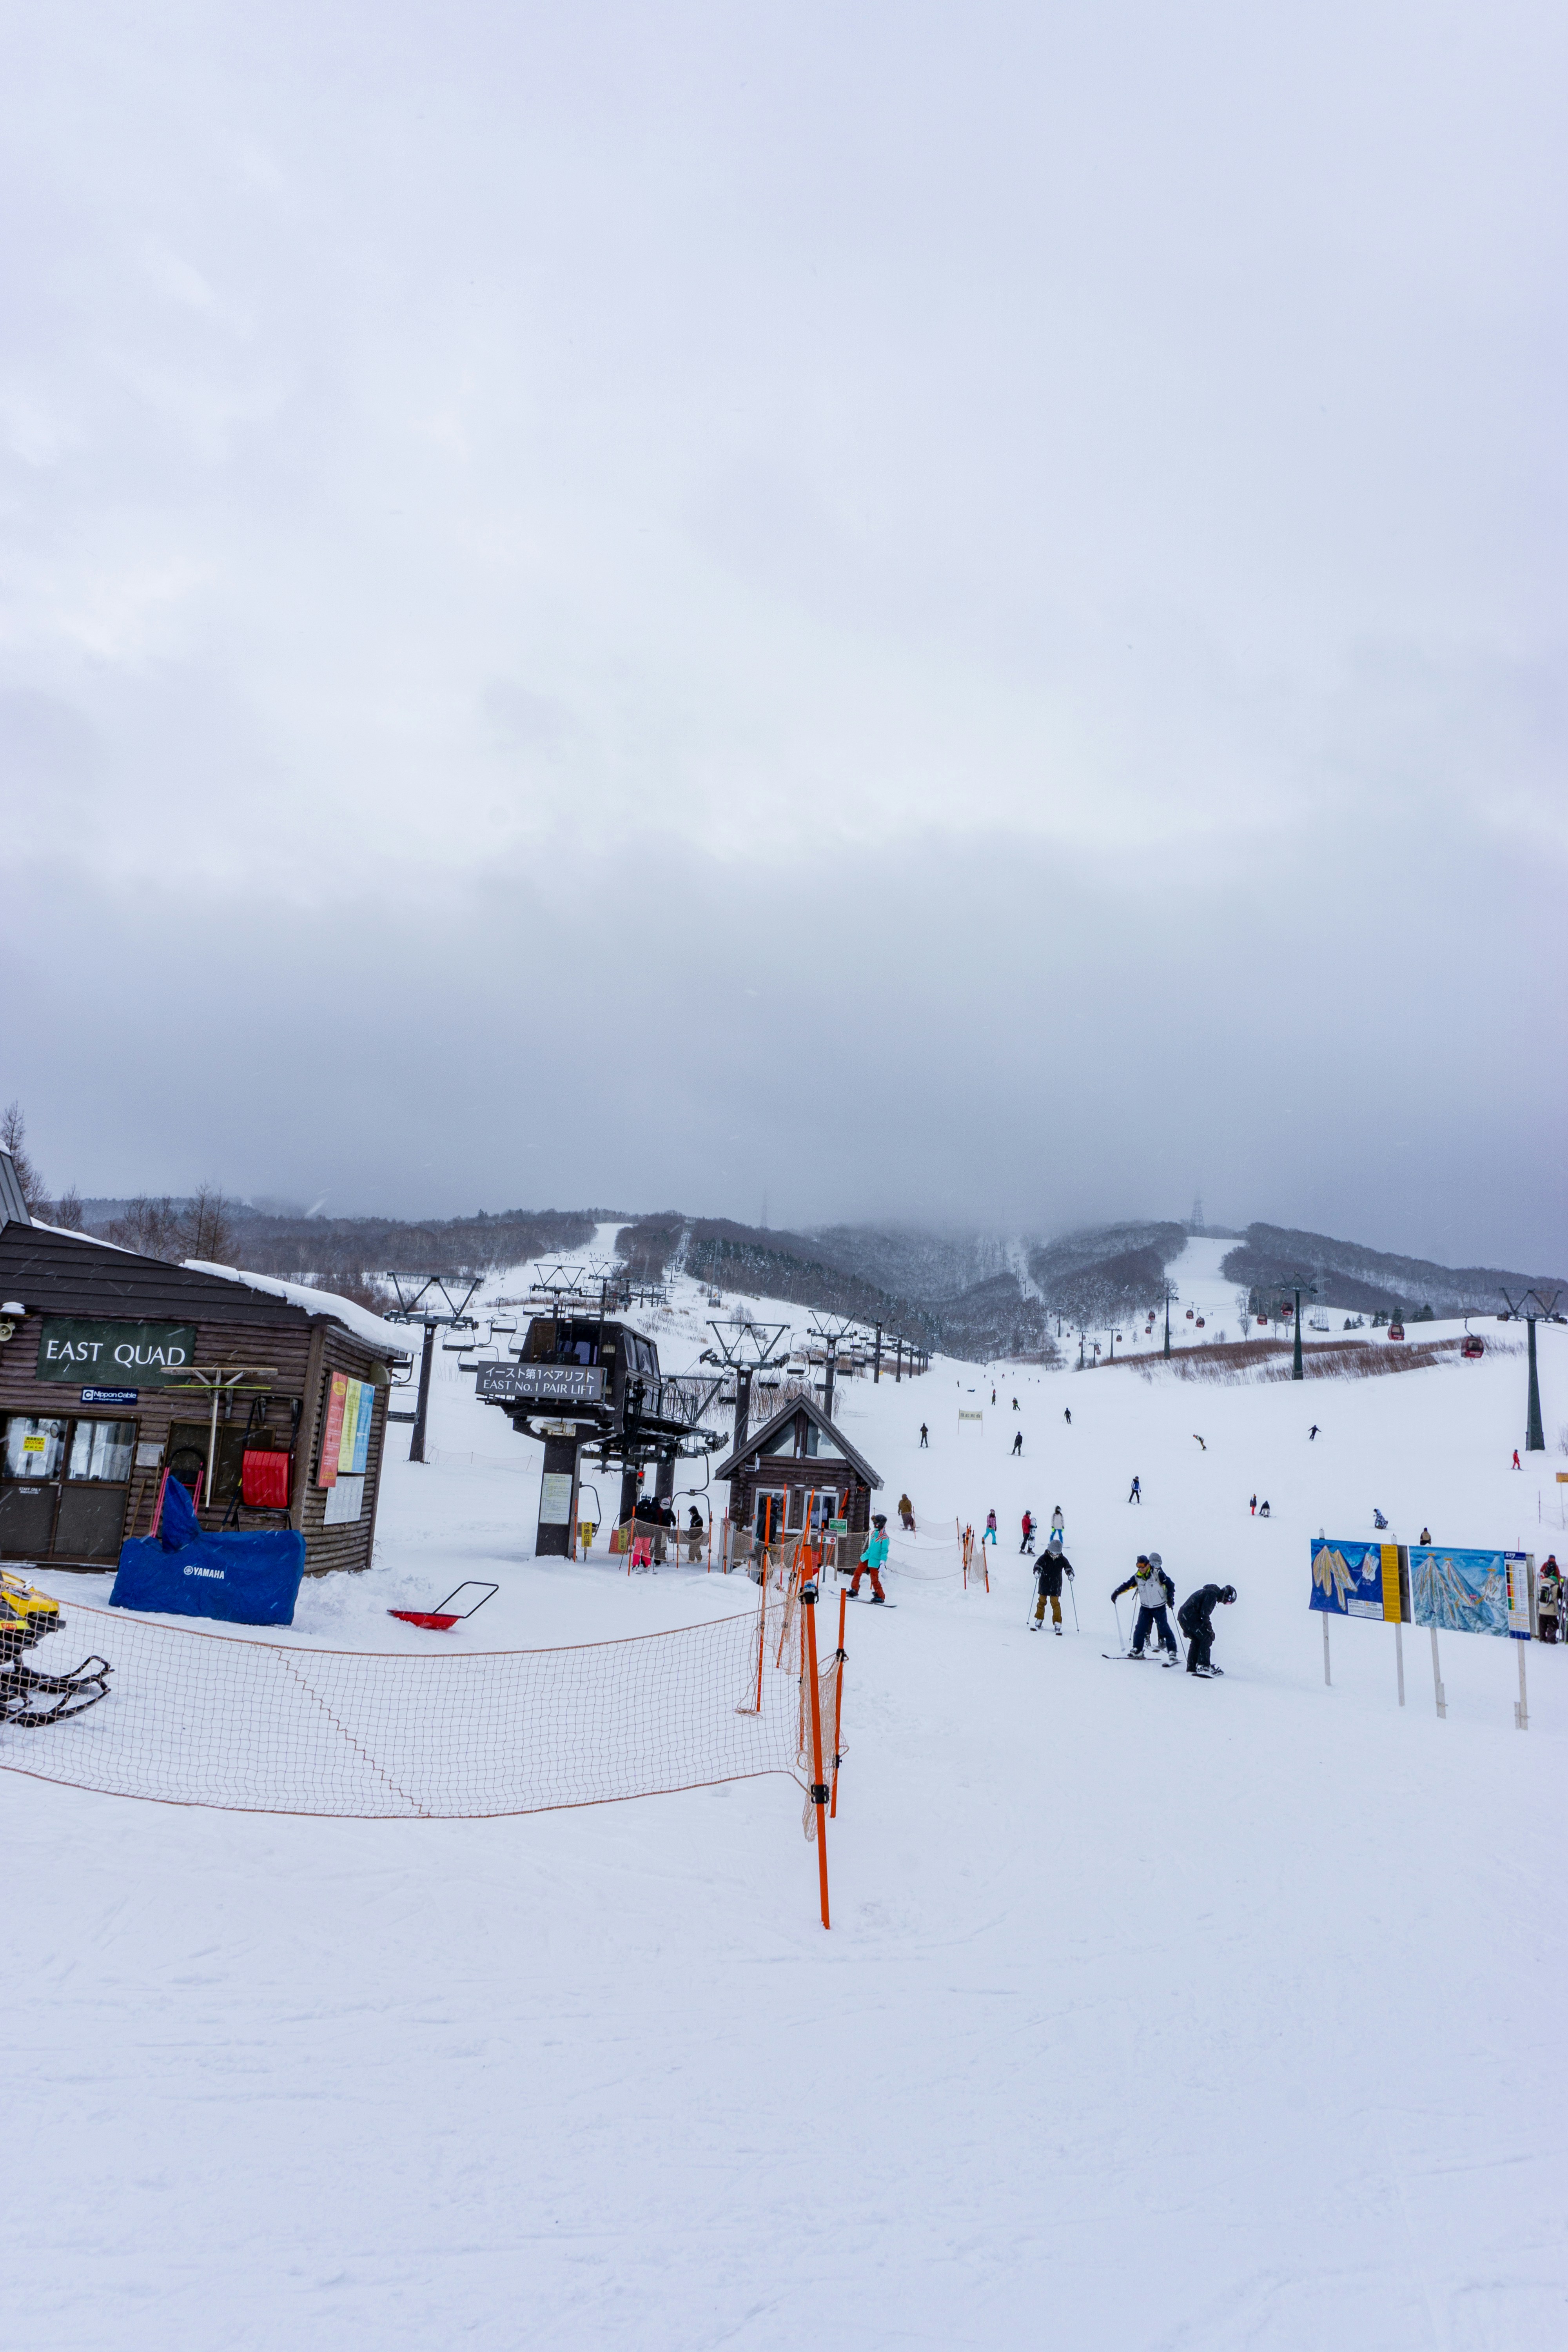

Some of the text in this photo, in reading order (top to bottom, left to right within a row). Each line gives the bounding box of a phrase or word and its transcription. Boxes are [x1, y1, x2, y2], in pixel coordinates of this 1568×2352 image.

[47, 1340, 185, 1368] EAST QUAD
[485, 1367, 594, 1382] イースト第1ペアリフト
[483, 1379, 595, 1395] EAST No.1 PAIR LIFT
[194, 1566, 225, 1579] YAMAHA
